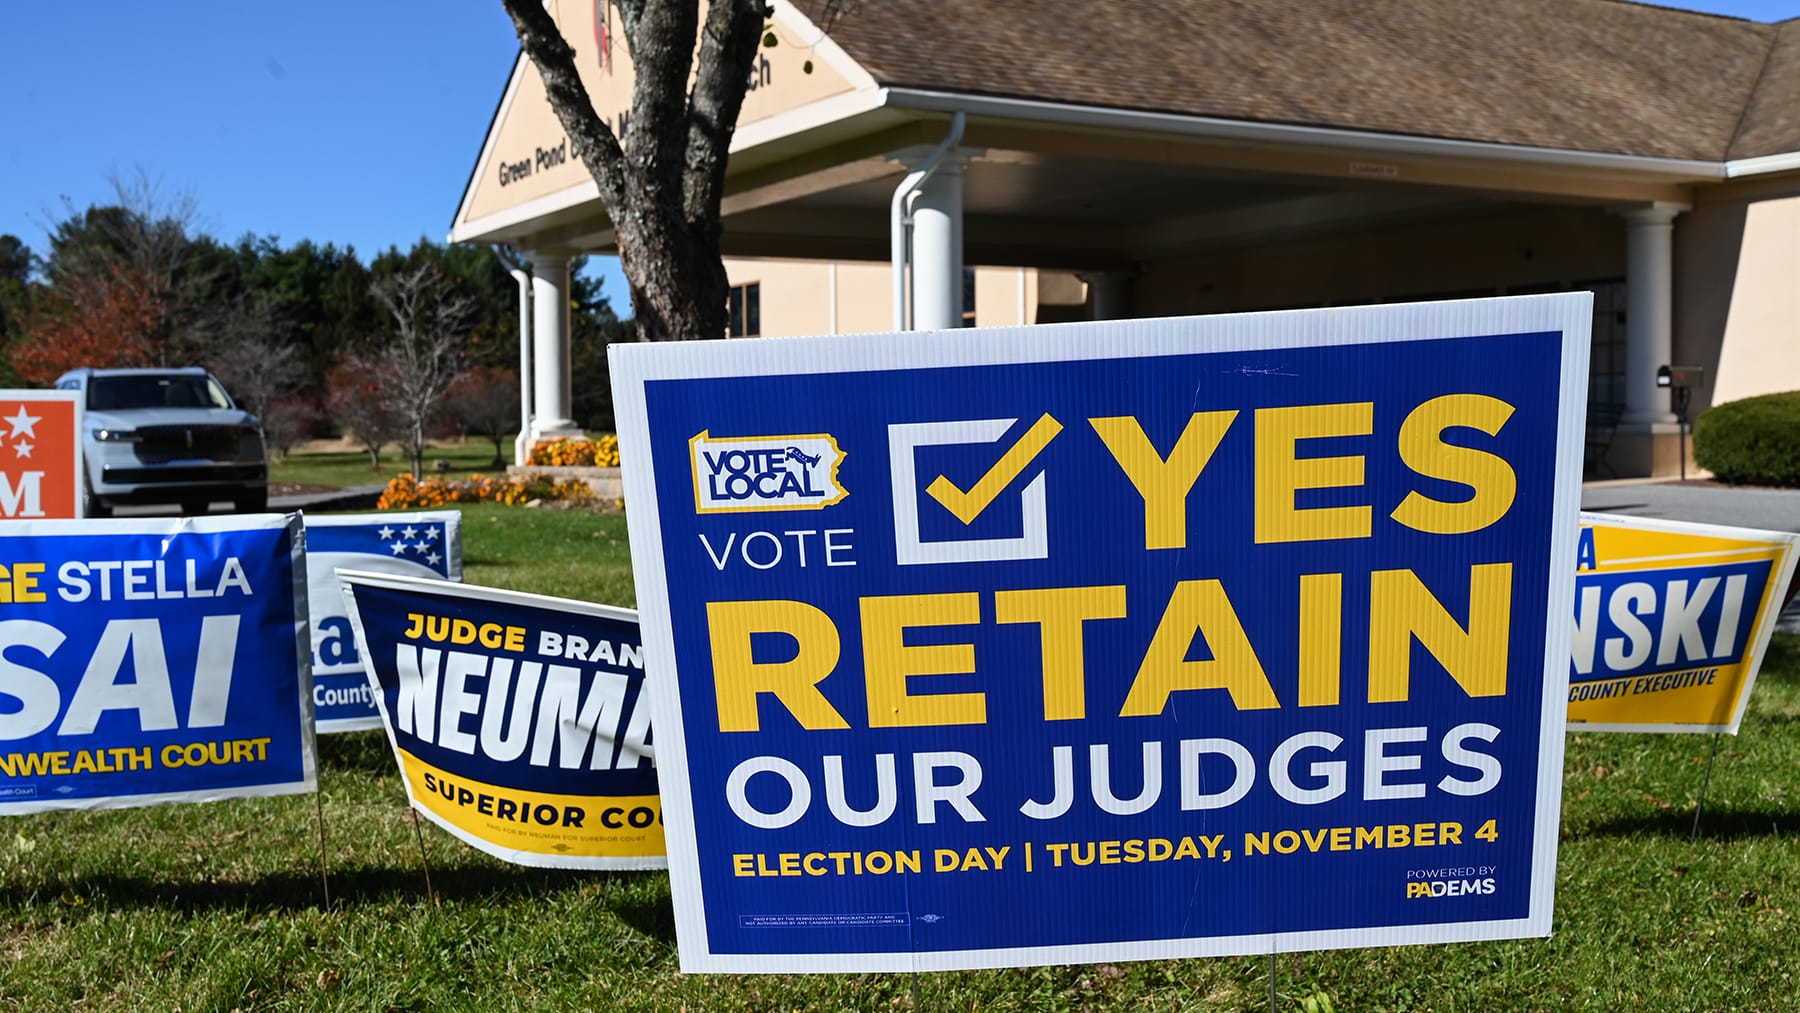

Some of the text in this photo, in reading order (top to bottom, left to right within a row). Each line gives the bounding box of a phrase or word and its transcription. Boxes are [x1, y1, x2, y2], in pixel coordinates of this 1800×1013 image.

[499, 158, 531, 187] Green
[536, 137, 566, 173] Pond
[703, 448, 787, 475] VOTE
[1089, 394, 1516, 549] YES
[709, 470, 825, 501] LOCAL
[698, 529, 857, 571] VOTE
[58, 556, 252, 602] STELLA
[405, 613, 527, 652] JUDGE
[707, 563, 1512, 732] RETAIN
[0, 614, 241, 741] SAI
[313, 683, 376, 709] County
[1568, 668, 1718, 702] COUNTY EXECUTIVE
[161, 737, 271, 768] COURT
[727, 722, 1503, 829] OUR JUDGES
[424, 772, 664, 829] SUPERIOR CO
[529, 831, 560, 839] NEUMAN
[733, 850, 921, 877] ELECTION
[934, 846, 1009, 872] DAY
[1047, 834, 1231, 867] TUESDAY,
[1246, 821, 1463, 856] NOVEMBER
[1475, 819, 1499, 842] 4
[1406, 878, 1496, 899] PADEMS
[1407, 866, 1496, 879] POWERED BY
